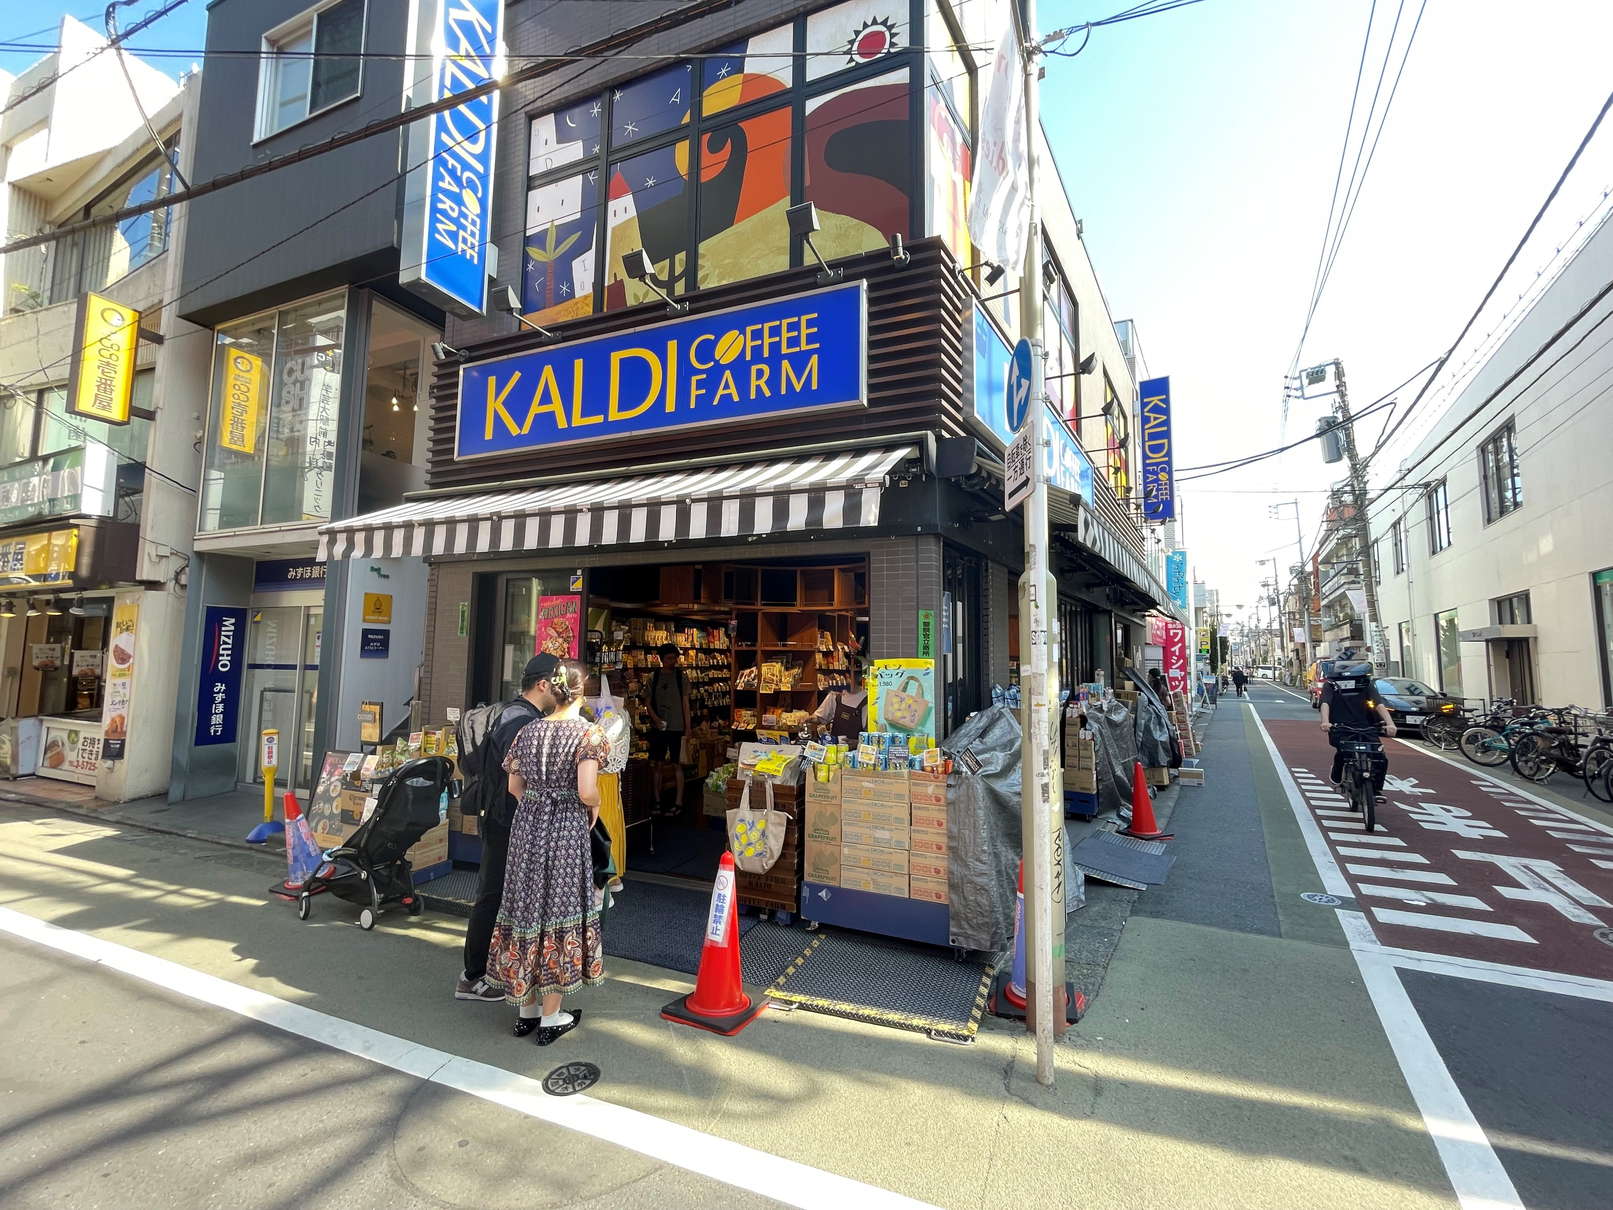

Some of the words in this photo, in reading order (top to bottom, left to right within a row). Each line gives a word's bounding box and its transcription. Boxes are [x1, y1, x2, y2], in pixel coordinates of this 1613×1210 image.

[440, 0, 493, 174] KALDI
[434, 149, 460, 250] FARM
[456, 170, 483, 265] COFFEE
[689, 312, 821, 370] COFFEE
[484, 339, 679, 440] KALDI
[689, 354, 820, 409] FARM
[1144, 395, 1169, 464] KALDI
[1158, 464, 1170, 502] COFFEE
[287, 565, 328, 580] みずほ銀行
[218, 616, 236, 672] MIZUHO
[209, 682, 226, 736] みずほ銀行
